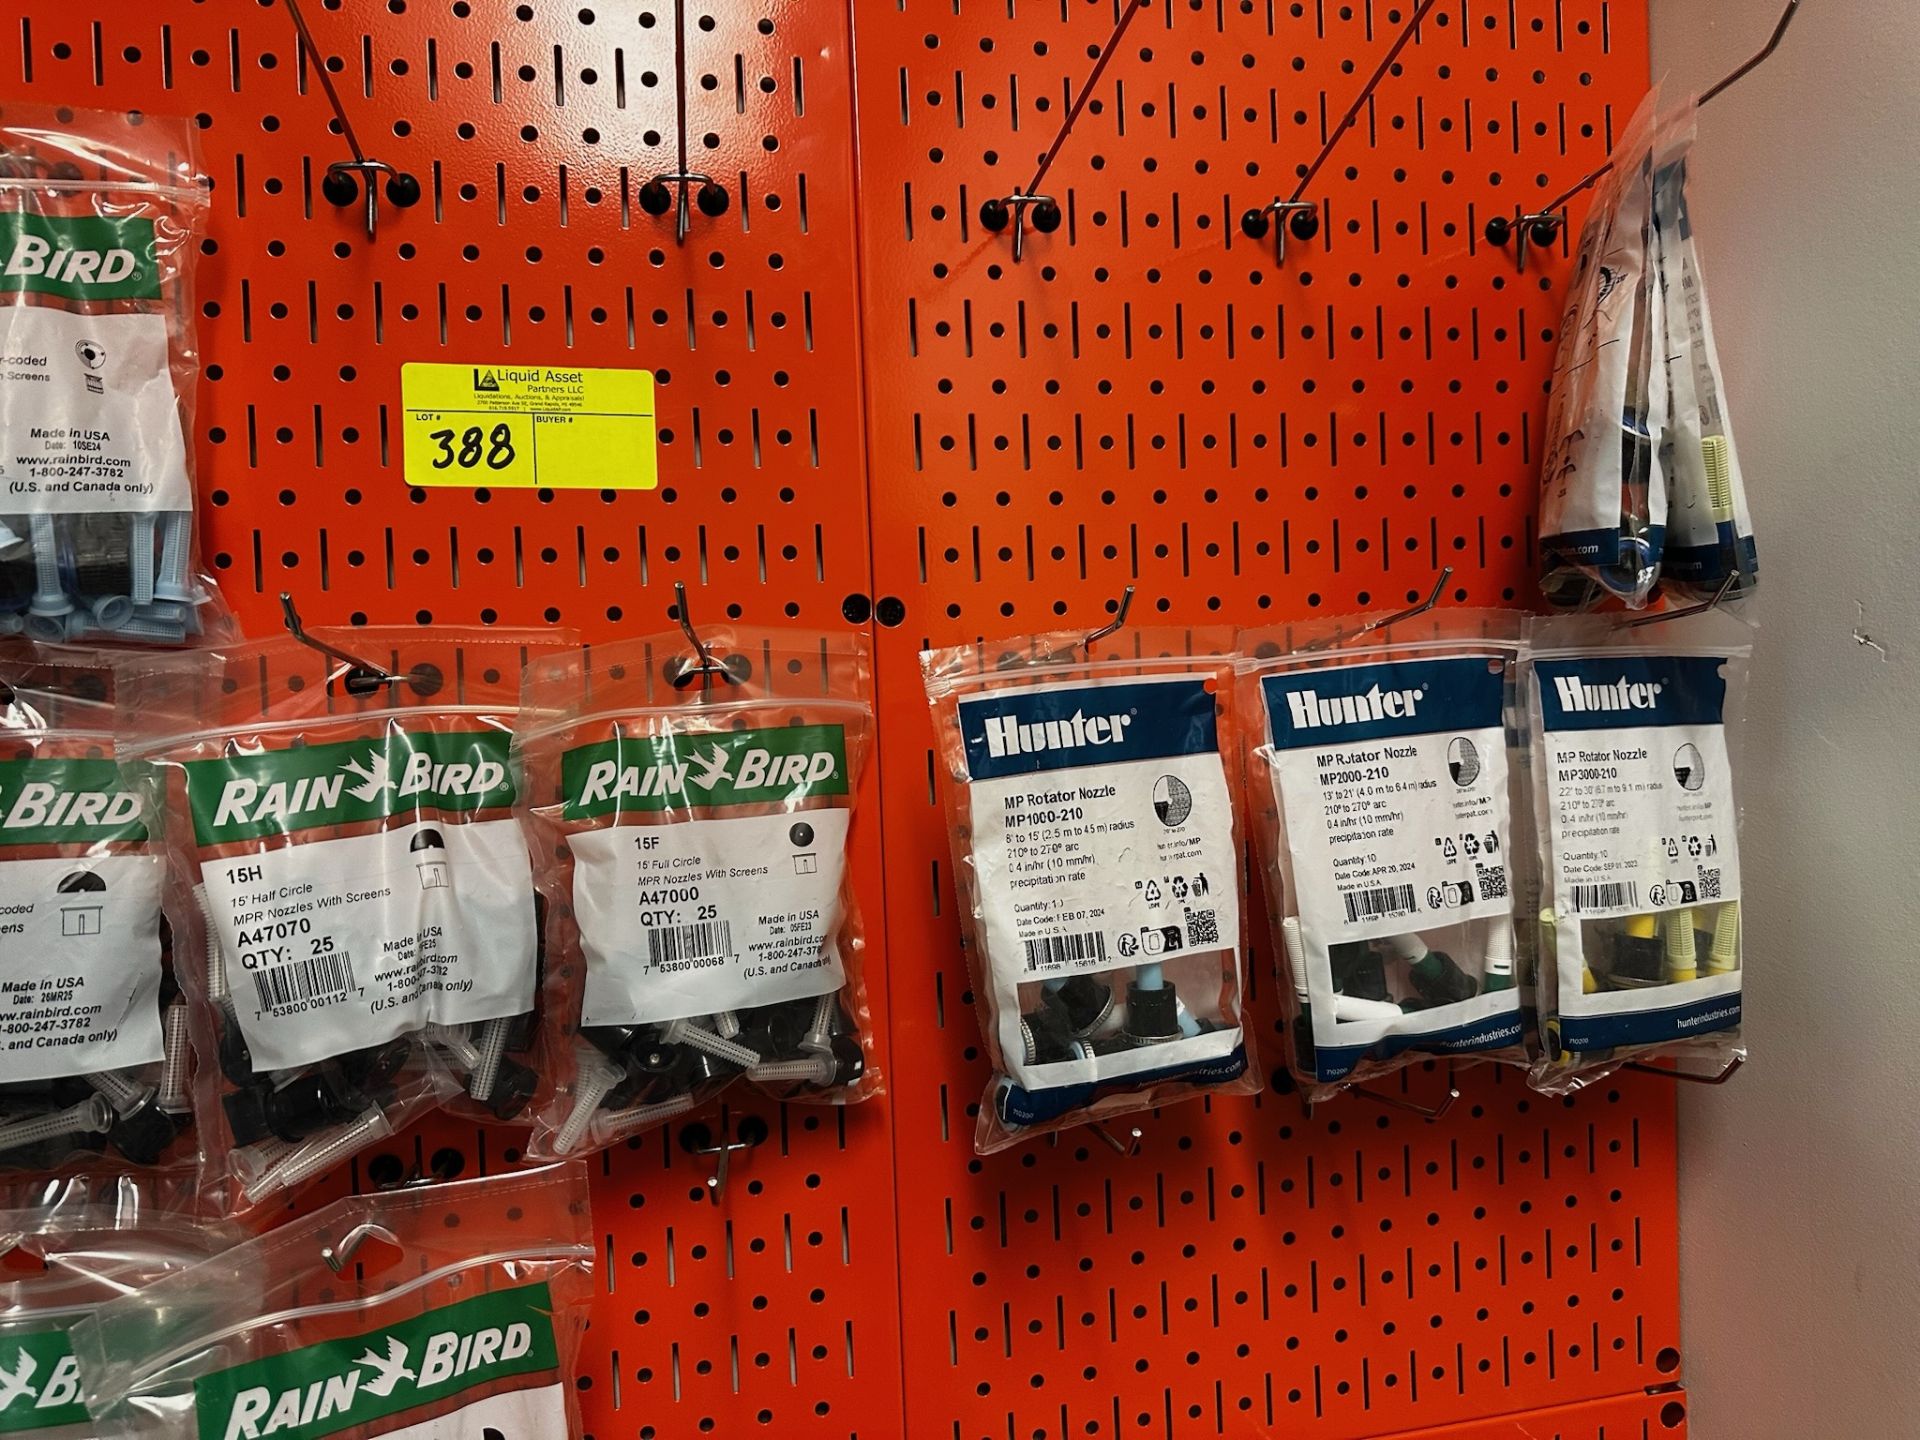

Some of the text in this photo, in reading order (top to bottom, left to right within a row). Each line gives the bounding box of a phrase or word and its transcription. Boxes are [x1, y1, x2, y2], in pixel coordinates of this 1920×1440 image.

[4, 234, 136, 284] BIRD
[7, 371, 50, 382] Screens
[498, 369, 583, 383] Liquid Asset
[527, 385, 584, 394] Partners LLC
[416, 413, 433, 421] LOT
[30, 428, 110, 441] Made in USA
[430, 423, 516, 470] 388
[16, 454, 131, 467] www.rainbird.com
[30, 467, 124, 477] 1-800-247-3782
[9, 481, 154, 494] (U.S. and Canada only)
[1553, 674, 1663, 712] Hunter
[1286, 683, 1424, 729] Hunter
[984, 707, 1131, 758] Hunter
[1316, 745, 1417, 767] MP Nozzle
[1557, 748, 1648, 763] MP Rotator Nozzle
[578, 748, 835, 807] RAIN BIRD
[1320, 766, 1389, 786] MP2000-210
[1558, 767, 1617, 782] MP3000-210
[213, 752, 504, 827] RAIN BIRD
[1004, 784, 1116, 810] MP Rotator Nozzle
[1336, 790, 1343, 799] to
[1386, 784, 1394, 793] to
[3, 782, 144, 829] BIRD
[1342, 800, 1387, 813] to arc
[1582, 800, 1589, 809] to
[1005, 807, 1083, 828] MP1000-210
[1359, 814, 1373, 827] (10
[1374, 810, 1404, 823] mm/hr)
[1015, 834, 1025, 842] to
[1063, 829, 1072, 837] m
[1074, 826, 1083, 836] to
[1096, 822, 1108, 834] m)
[1109, 820, 1135, 831] radius
[1378, 828, 1394, 838] rate
[635, 836, 660, 850] 15F
[1030, 843, 1079, 856] to arc
[652, 859, 669, 869] Full
[672, 856, 701, 868] Circle
[1024, 854, 1095, 871] in/hr (10 mm/hr)
[1367, 853, 1377, 863] 10
[226, 865, 263, 884] 15H
[637, 865, 769, 886] MPR Nozzles With Screens
[1068, 871, 1086, 882] rate
[1335, 872, 1351, 881] Date
[1371, 866, 1387, 875] APR
[1399, 862, 1416, 872] 2024
[1563, 865, 1582, 873] Date
[231, 884, 313, 908] 15' Half Circle
[638, 886, 699, 906] A47000
[1337, 883, 1355, 891] Made
[233, 887, 391, 926] MPR Nozzles With Screens
[640, 904, 717, 927] QTY: 25
[758, 909, 819, 925] Made in USA
[1016, 917, 1032, 927] Date
[1033, 915, 1056, 925] Code:
[1089, 908, 1105, 918] 2024
[237, 917, 311, 947] A47070
[383, 926, 443, 952] Made USA
[241, 936, 334, 970] QTY: 25
[643, 953, 740, 975] 7 53800 00068 7
[743, 963, 788, 980] (U.S. and
[1, 976, 85, 993] Made in USA
[13, 994, 34, 1005] Date:
[255, 987, 365, 1021] 7 53800 00112 7
[370, 978, 473, 1014] (U.S. only)
[8, 1037, 33, 1050] and
[36, 1033, 84, 1048] Canada
[88, 1028, 118, 1043] only)
[223, 1322, 532, 1440] RAIN BIRD
